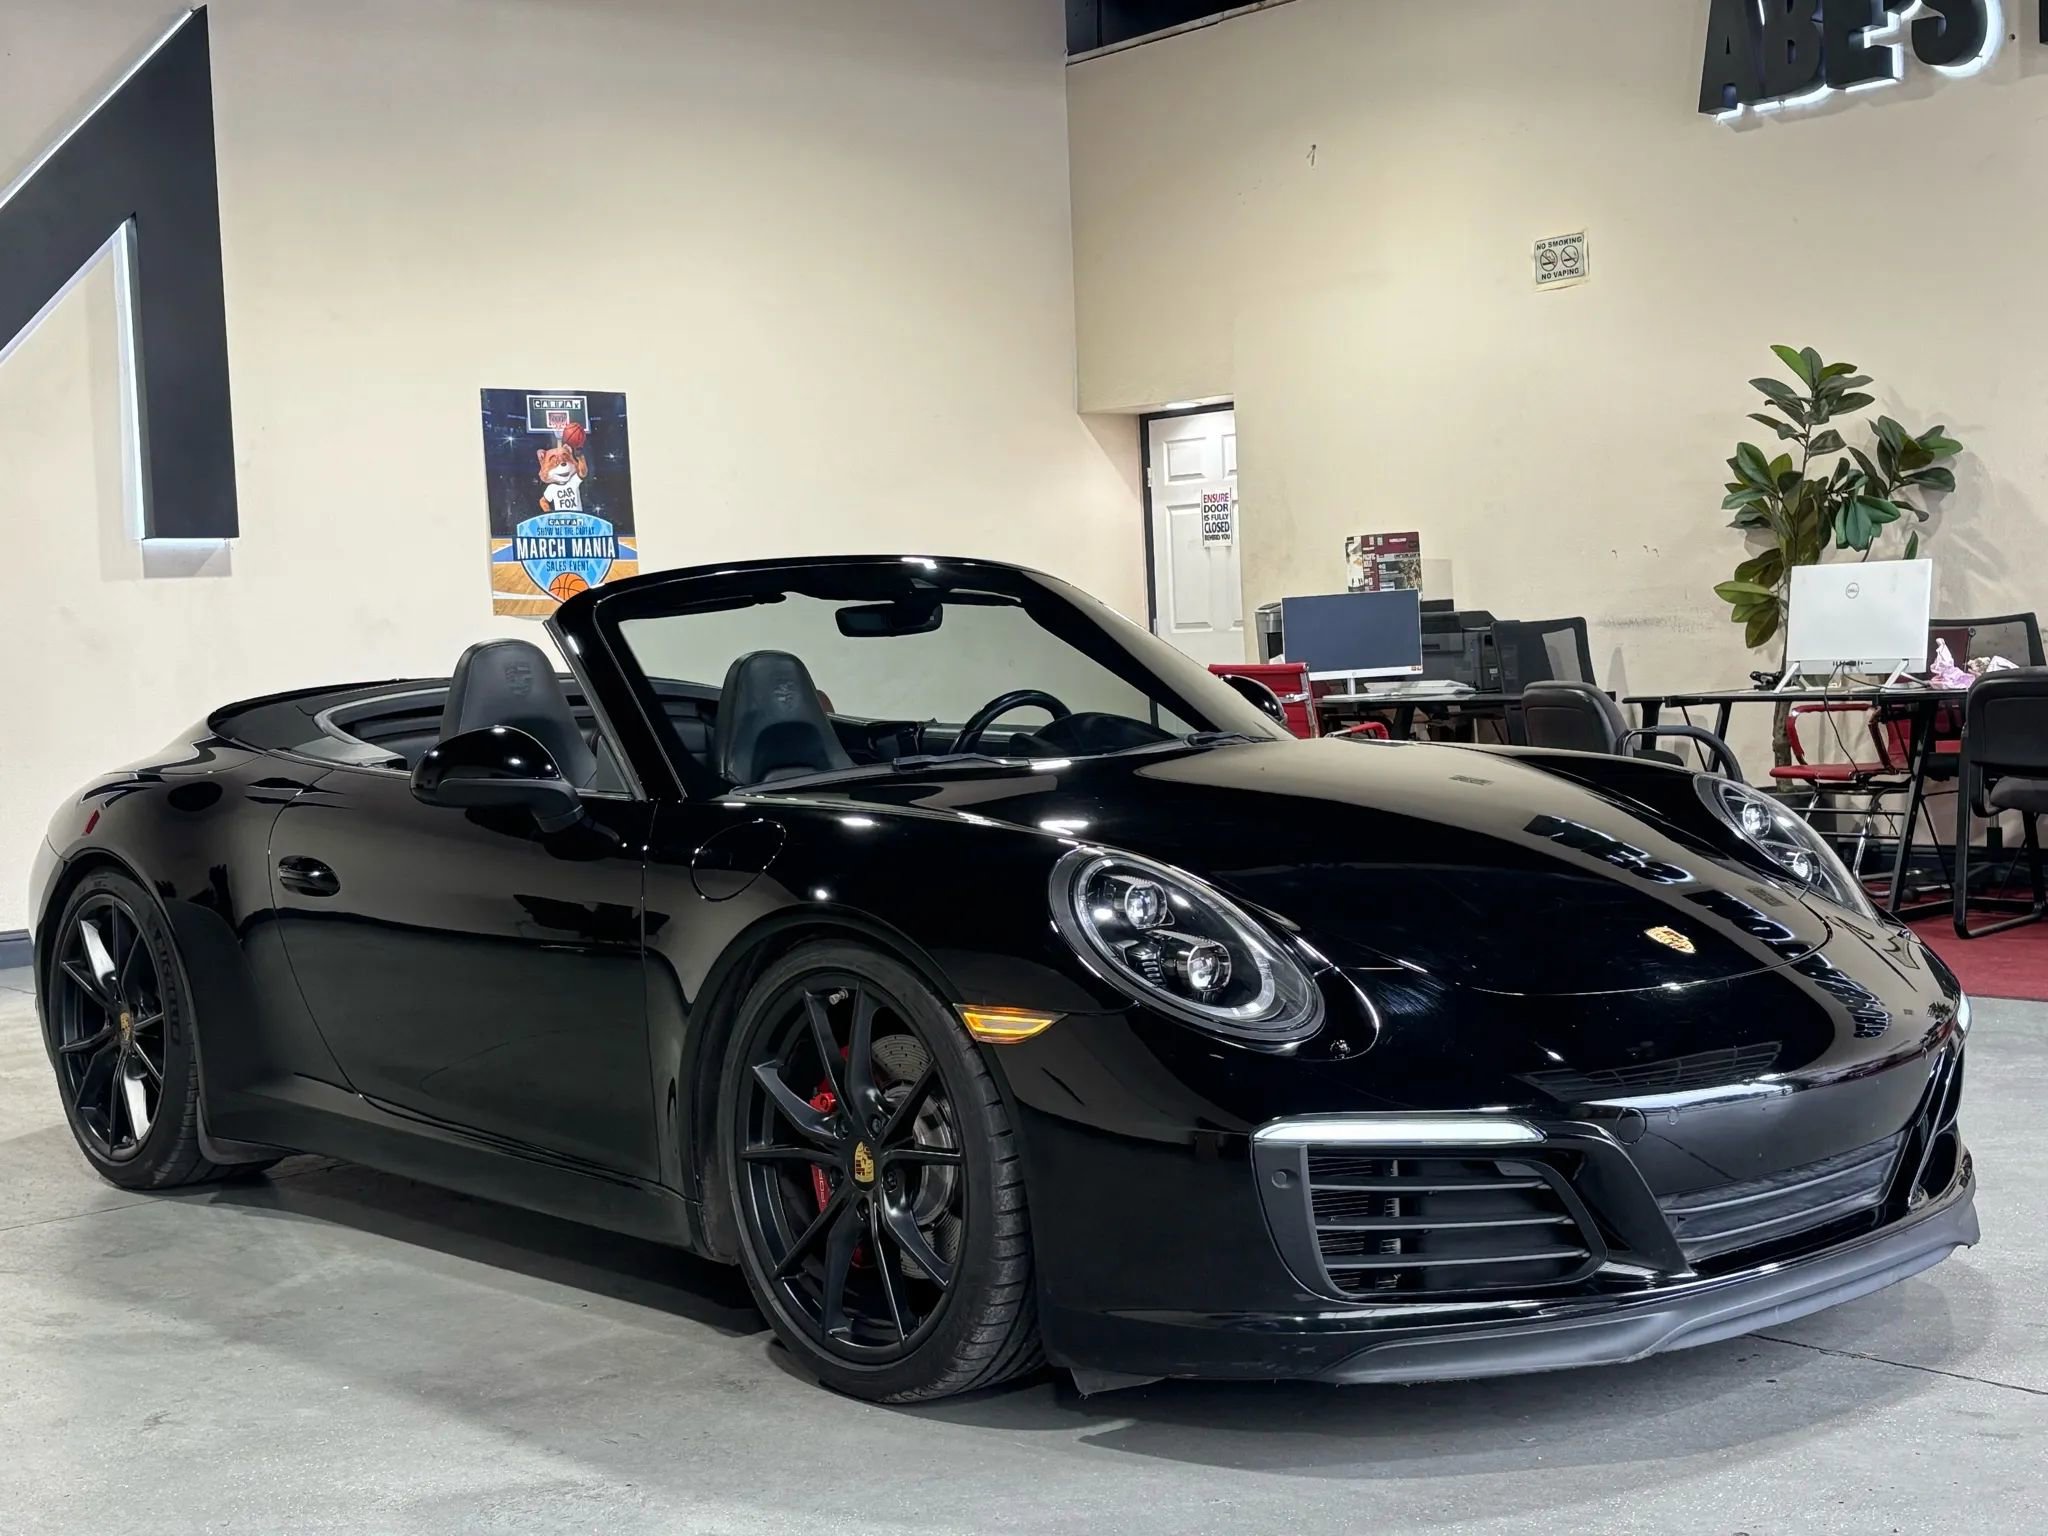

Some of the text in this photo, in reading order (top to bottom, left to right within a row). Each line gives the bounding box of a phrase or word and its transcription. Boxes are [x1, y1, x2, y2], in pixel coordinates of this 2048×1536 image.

[1536, 236, 1582, 251] NO SMOKING
[1553, 268, 1579, 278] VAPING
[533, 399, 581, 409] CARFAX
[557, 487, 575, 498] CAR
[1203, 492, 1229, 504] ENSURE
[559, 497, 577, 508] FOX
[1203, 503, 1229, 513] DOOR
[1211, 513, 1229, 521] FULLY
[1204, 521, 1230, 533] CLOSED
[516, 536, 616, 560] MARCH MANIA
[546, 560, 590, 572] SALES EVENT
